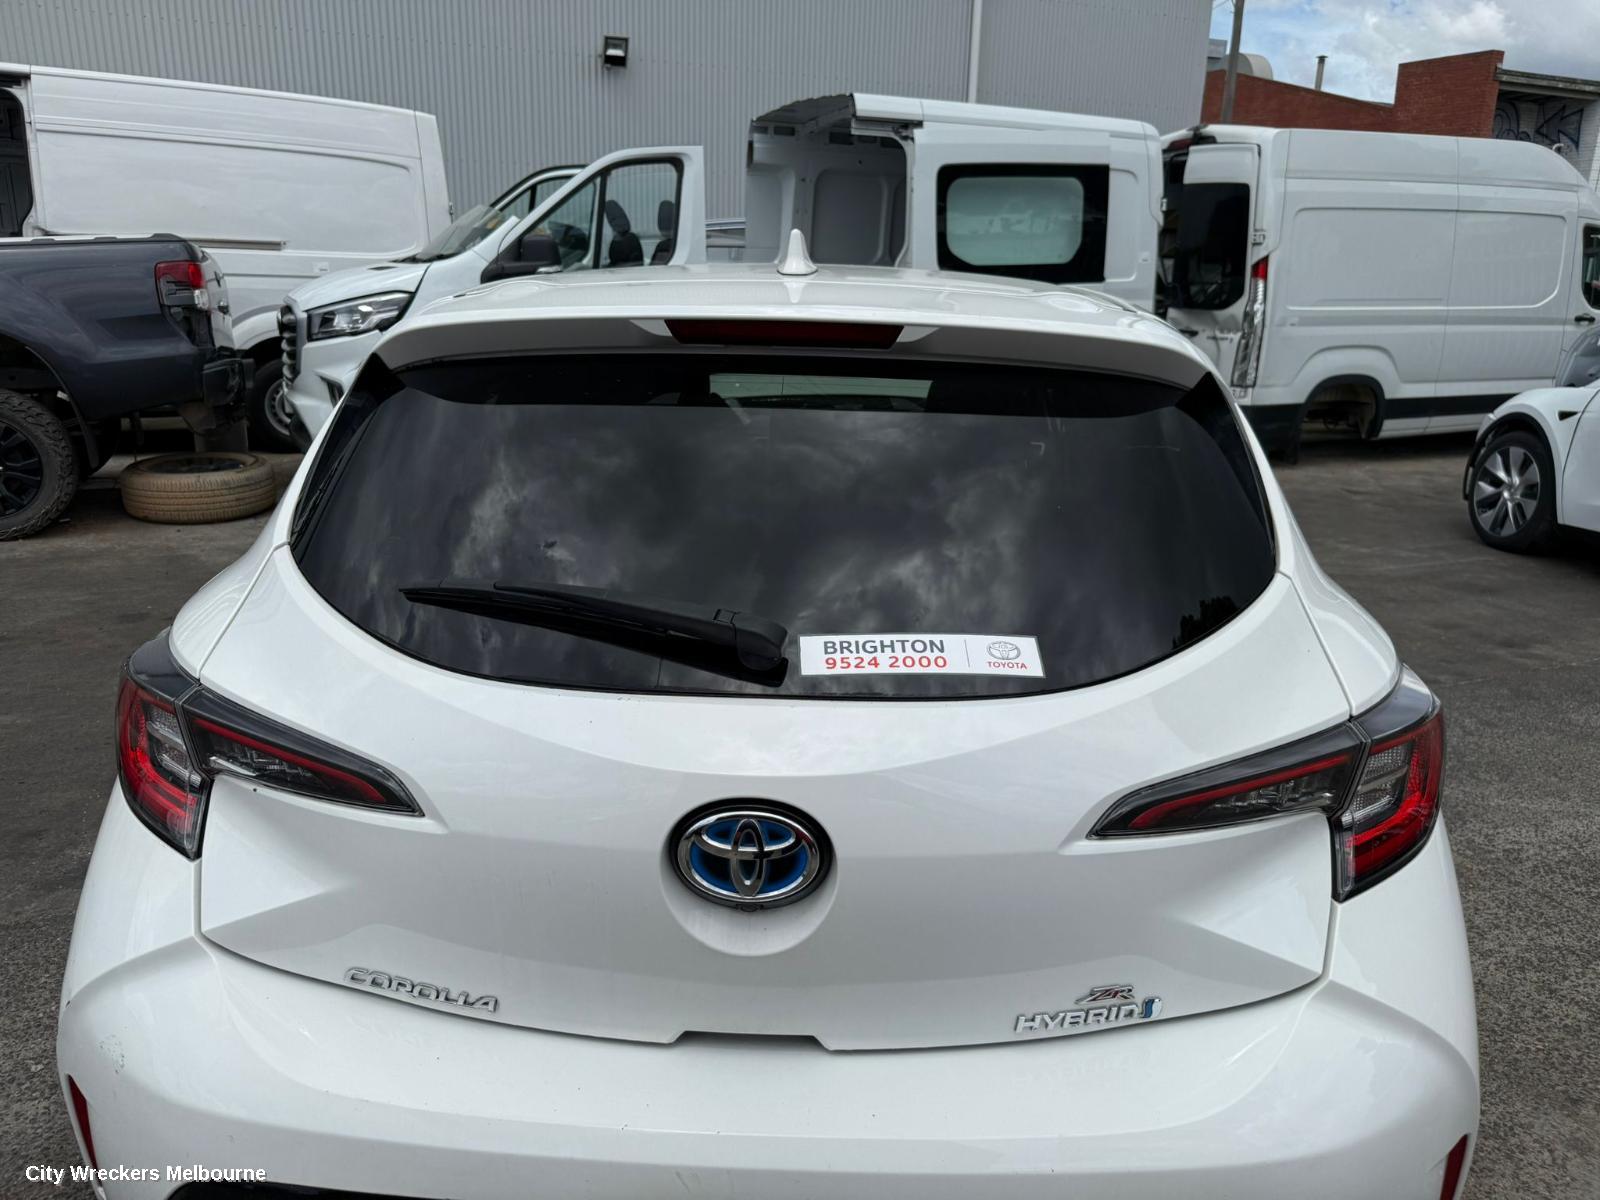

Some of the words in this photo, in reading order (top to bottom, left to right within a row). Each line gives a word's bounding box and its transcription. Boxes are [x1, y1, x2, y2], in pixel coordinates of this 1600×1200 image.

[823, 639, 945, 655] BRIGHTON
[825, 655, 880, 670] 9524
[888, 655, 948, 669] 2000
[987, 661, 1028, 670] TOYOTA
[344, 966, 499, 1013] COROLLA
[1075, 984, 1136, 1005] ZR
[1014, 1003, 1139, 1034] HYBRID
